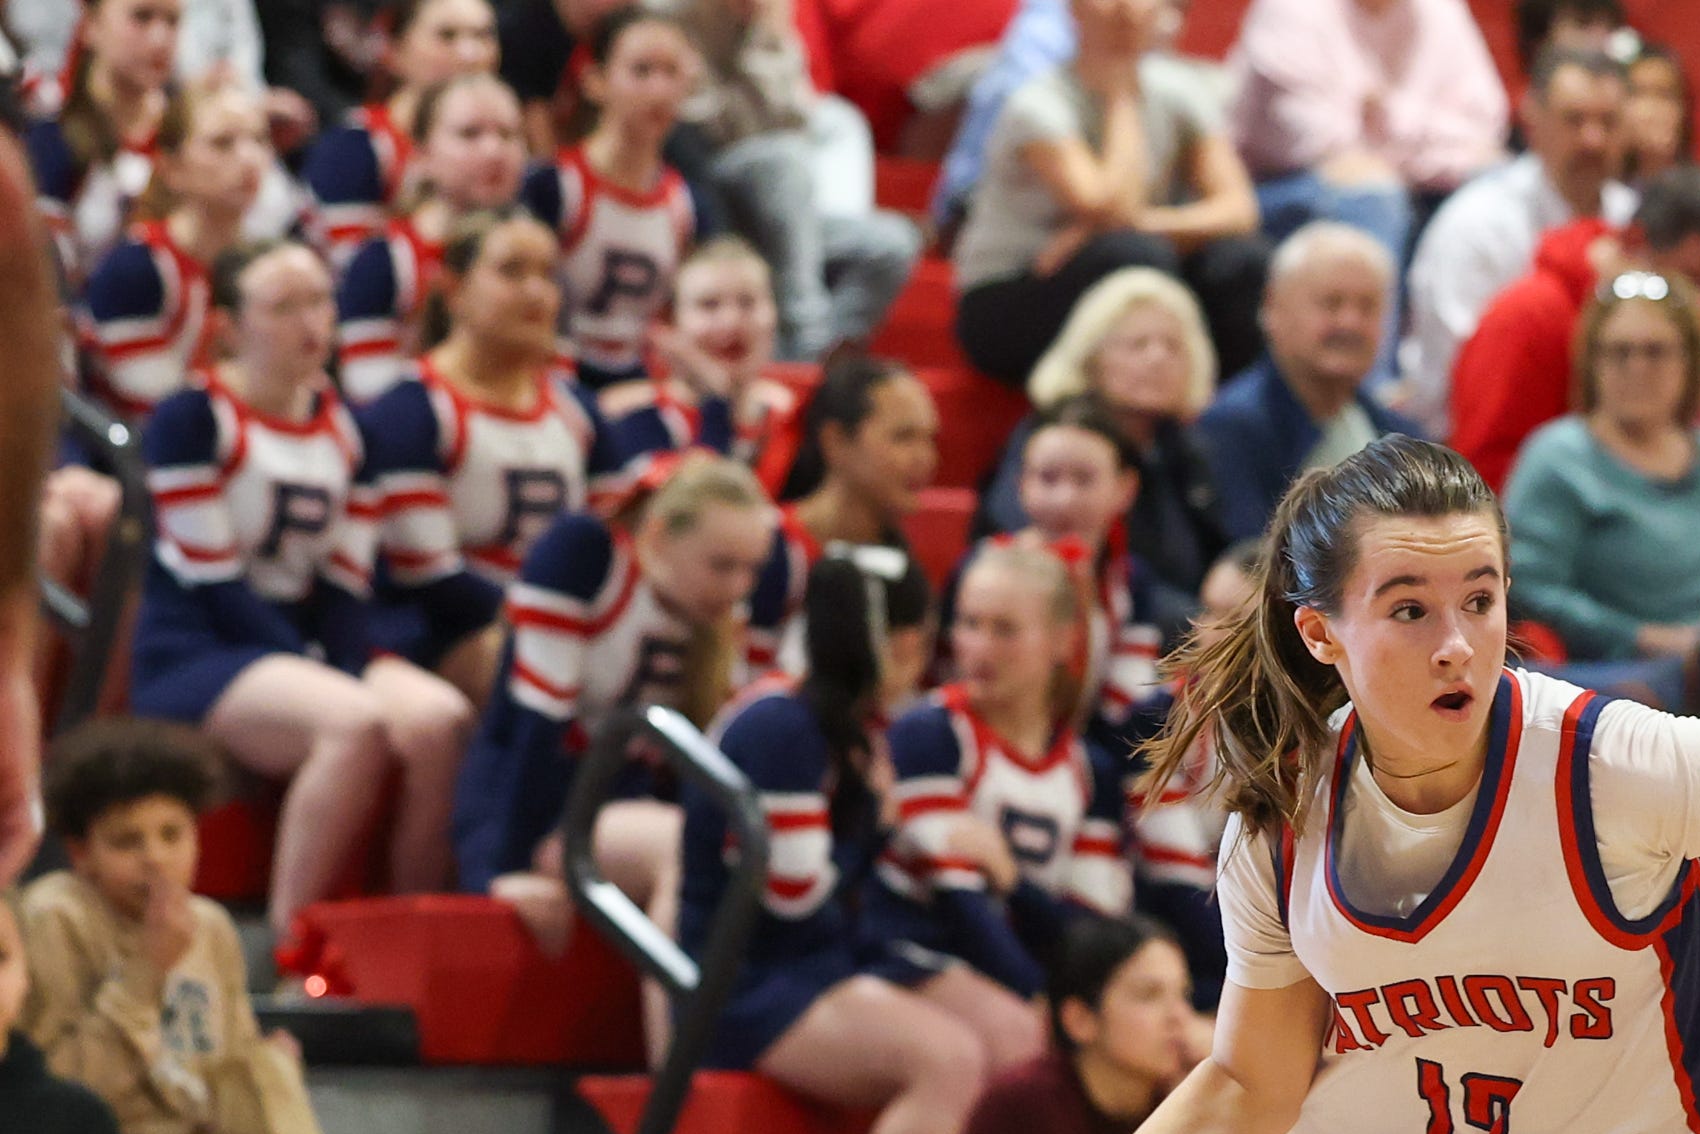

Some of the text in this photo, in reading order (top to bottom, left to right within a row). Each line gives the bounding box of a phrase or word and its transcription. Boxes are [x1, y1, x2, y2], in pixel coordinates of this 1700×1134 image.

[584, 248, 659, 314] P
[257, 481, 332, 557] P
[500, 467, 567, 544] P
[1323, 974, 1616, 1054] ATRIOTS
